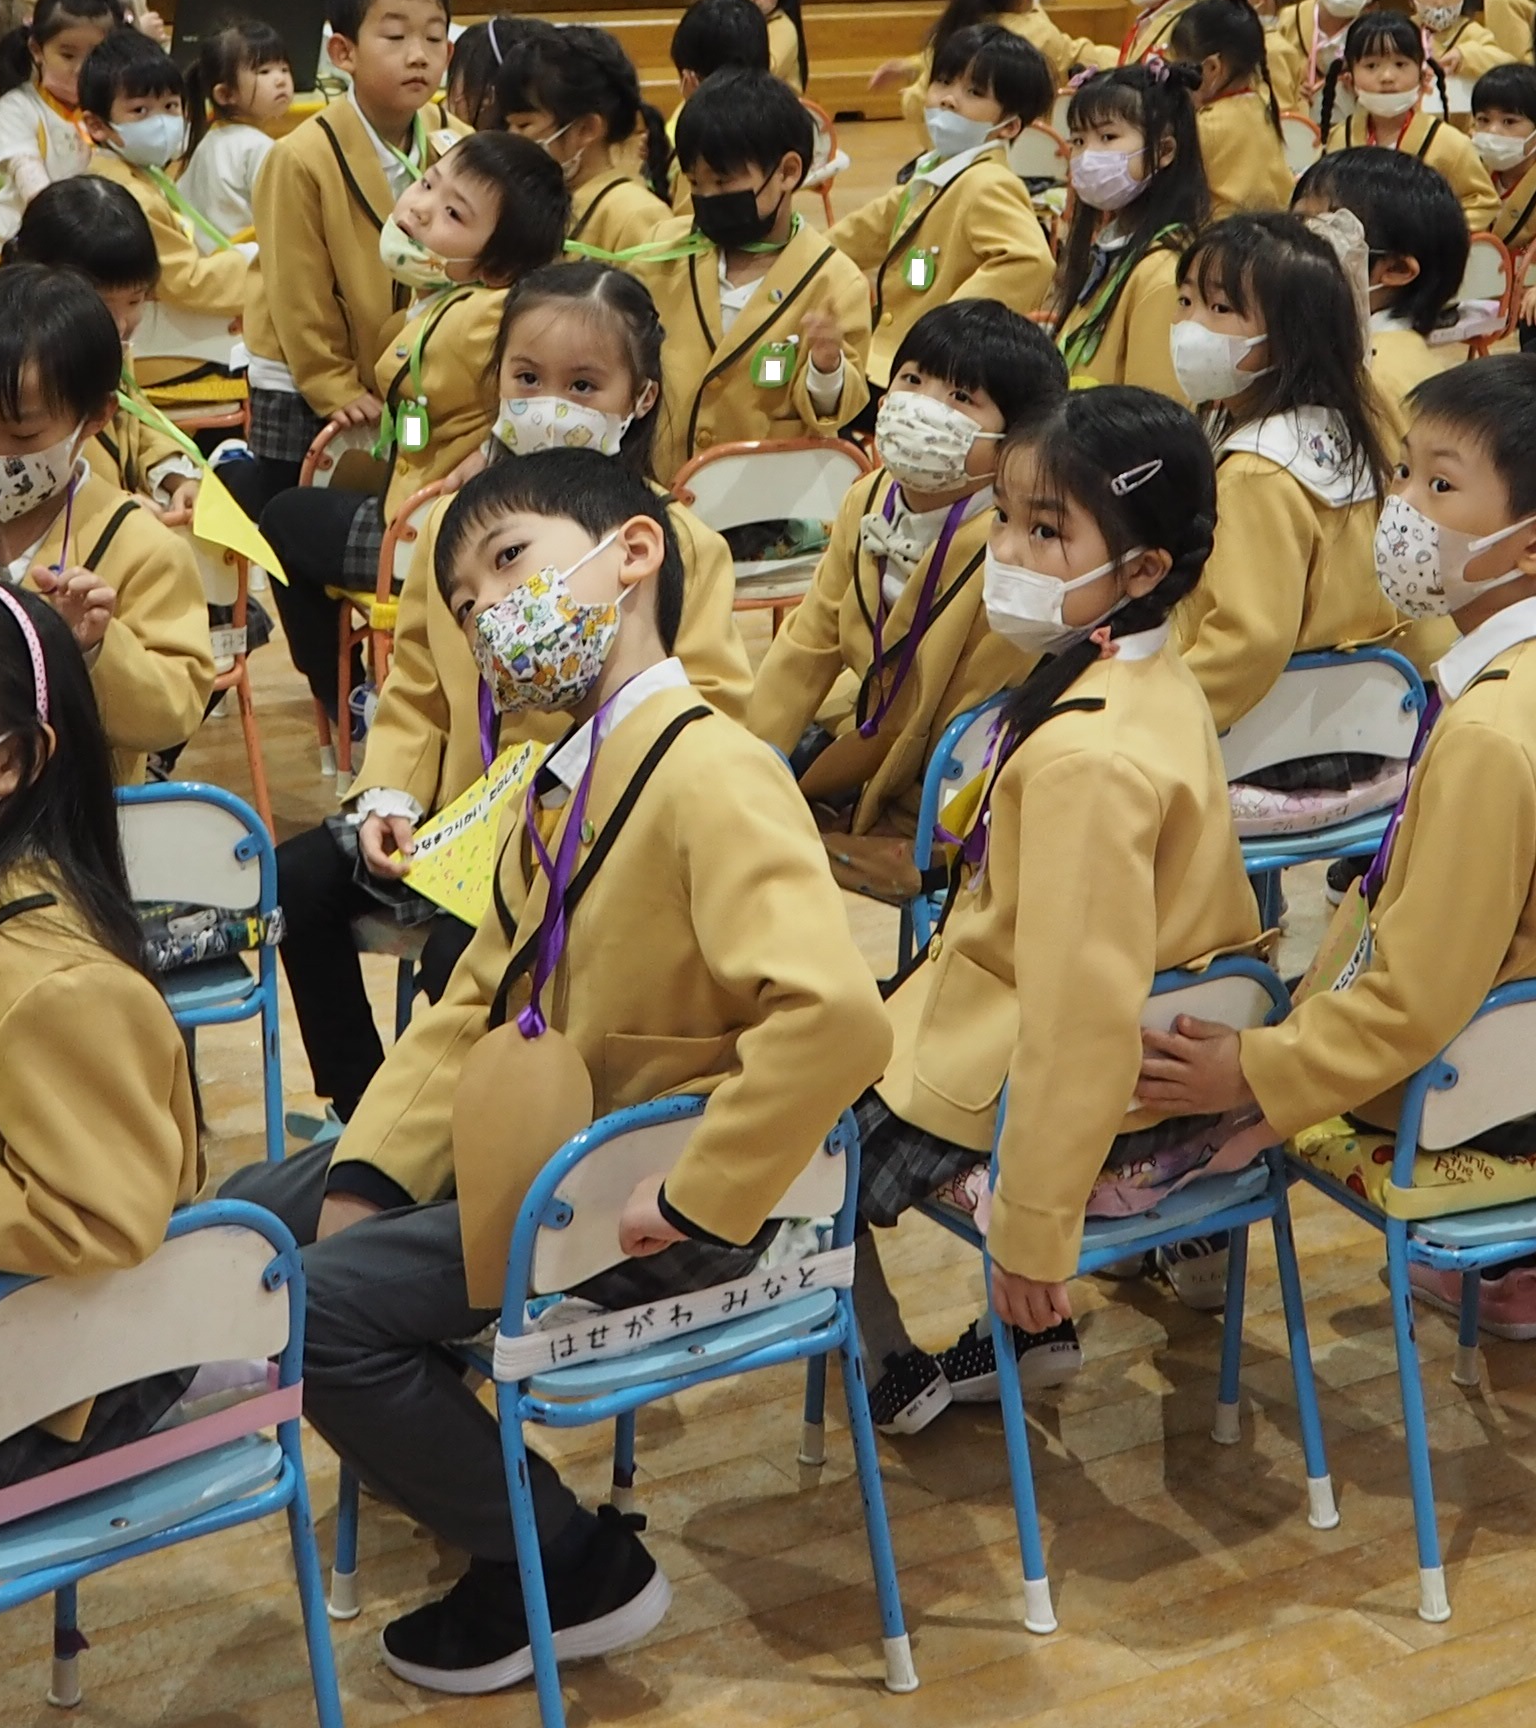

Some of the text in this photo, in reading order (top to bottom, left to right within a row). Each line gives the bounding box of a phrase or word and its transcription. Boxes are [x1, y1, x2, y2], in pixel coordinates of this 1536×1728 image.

[549, 1266, 817, 1365] はせがわ みなと
